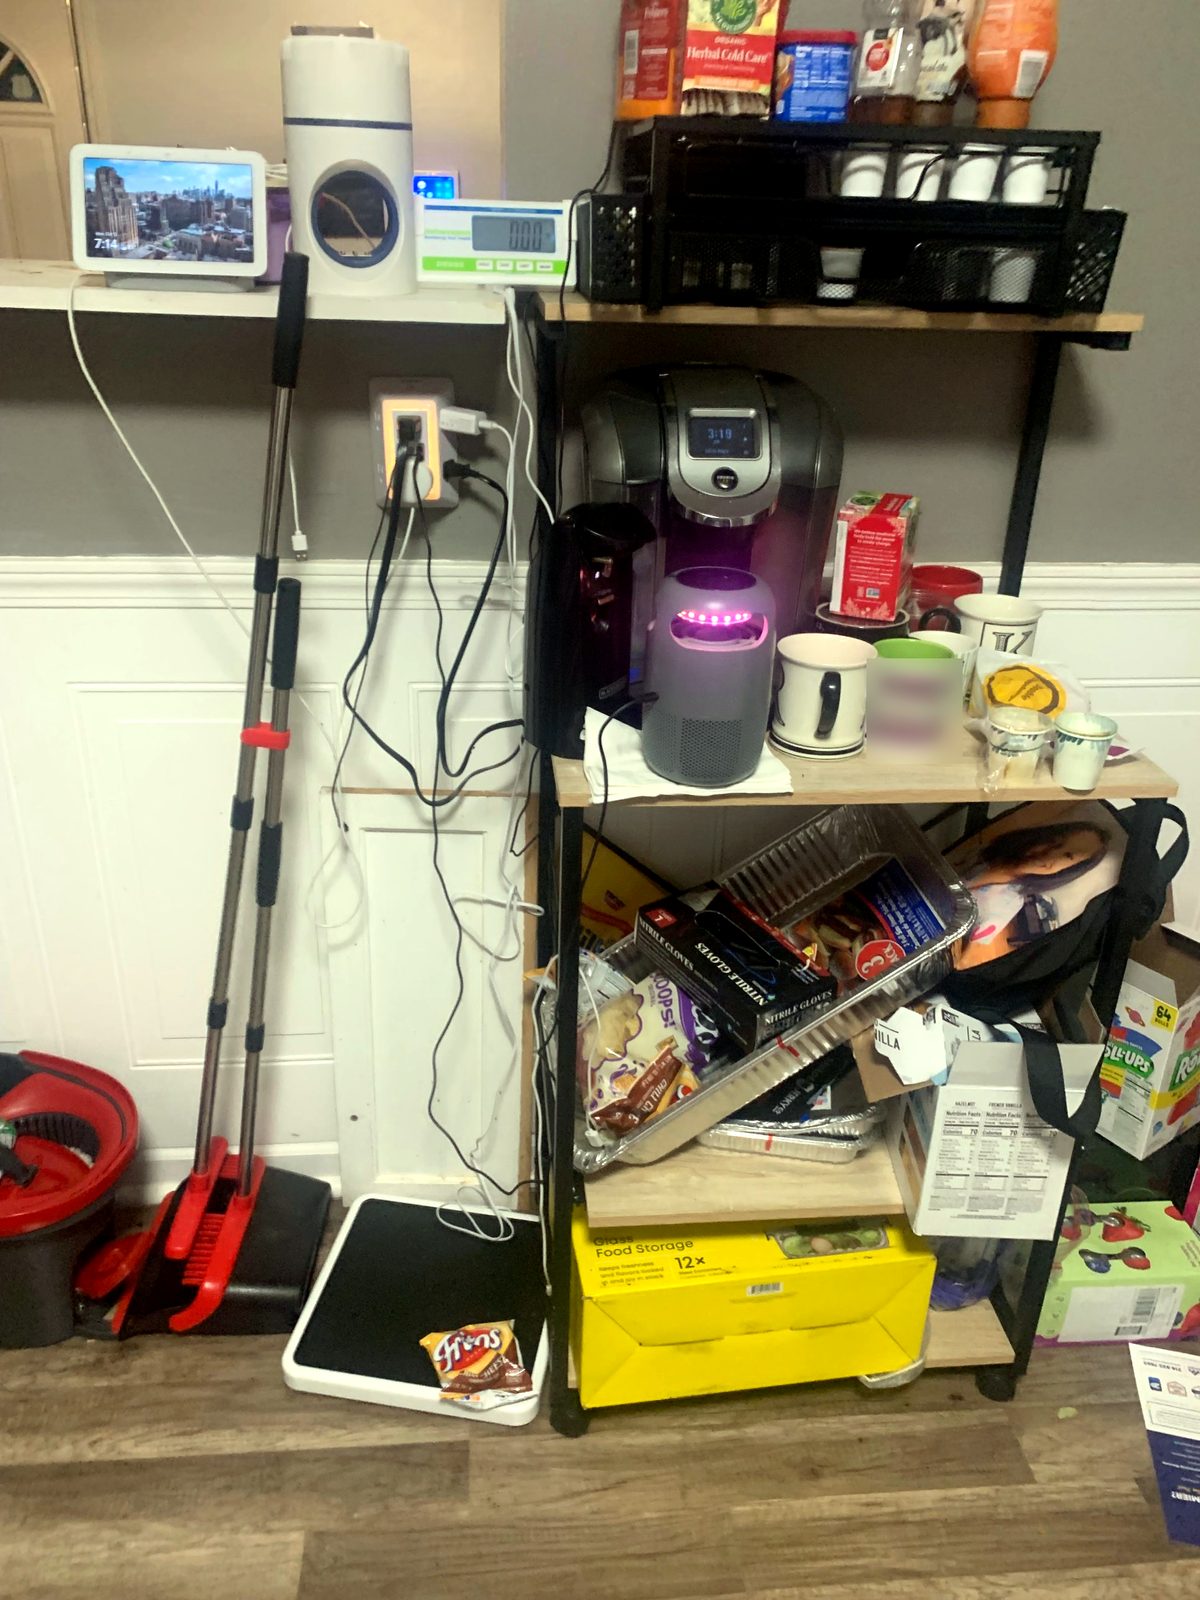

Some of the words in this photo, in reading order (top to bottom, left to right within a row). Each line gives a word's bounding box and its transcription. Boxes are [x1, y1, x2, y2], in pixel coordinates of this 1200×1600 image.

[686, 46, 719, 61] Herbal
[720, 49, 745, 63] Cold
[745, 52, 768, 64] Care
[93, 238, 118, 249] 7:14
[707, 428, 733, 440] 3:19
[639, 917, 667, 944] NITRILE
[665, 942, 694, 971] GLOVES
[695, 942, 733, 974] GLOVES
[861, 956, 885, 974] 3
[728, 967, 769, 1006] NITRILE
[652, 972, 676, 1028] OOPS!
[765, 1005, 797, 1025] NITRILE
[797, 989, 833, 1011] GLOVES
[1156, 1005, 1172, 1022] 64
[651, 1079, 668, 1102] CHILI
[593, 1235, 634, 1247] Glass
[597, 1246, 633, 1258] Food
[636, 1240, 694, 1254] Storage
